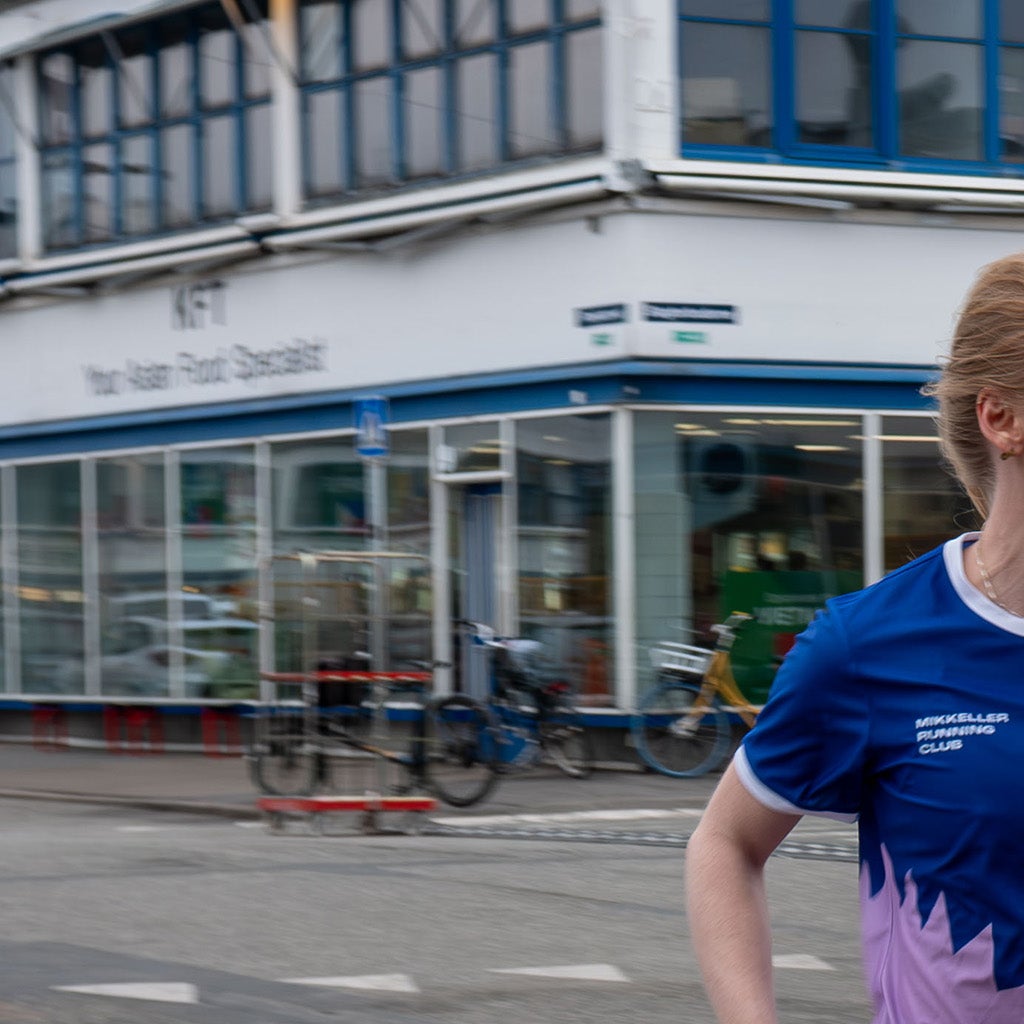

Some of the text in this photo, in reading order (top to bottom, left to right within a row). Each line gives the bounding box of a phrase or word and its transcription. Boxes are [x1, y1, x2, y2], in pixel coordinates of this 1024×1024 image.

[915, 713, 1010, 729] MIKKELLER
[916, 724, 996, 742] RUNNING
[918, 739, 963, 755] CLUB
